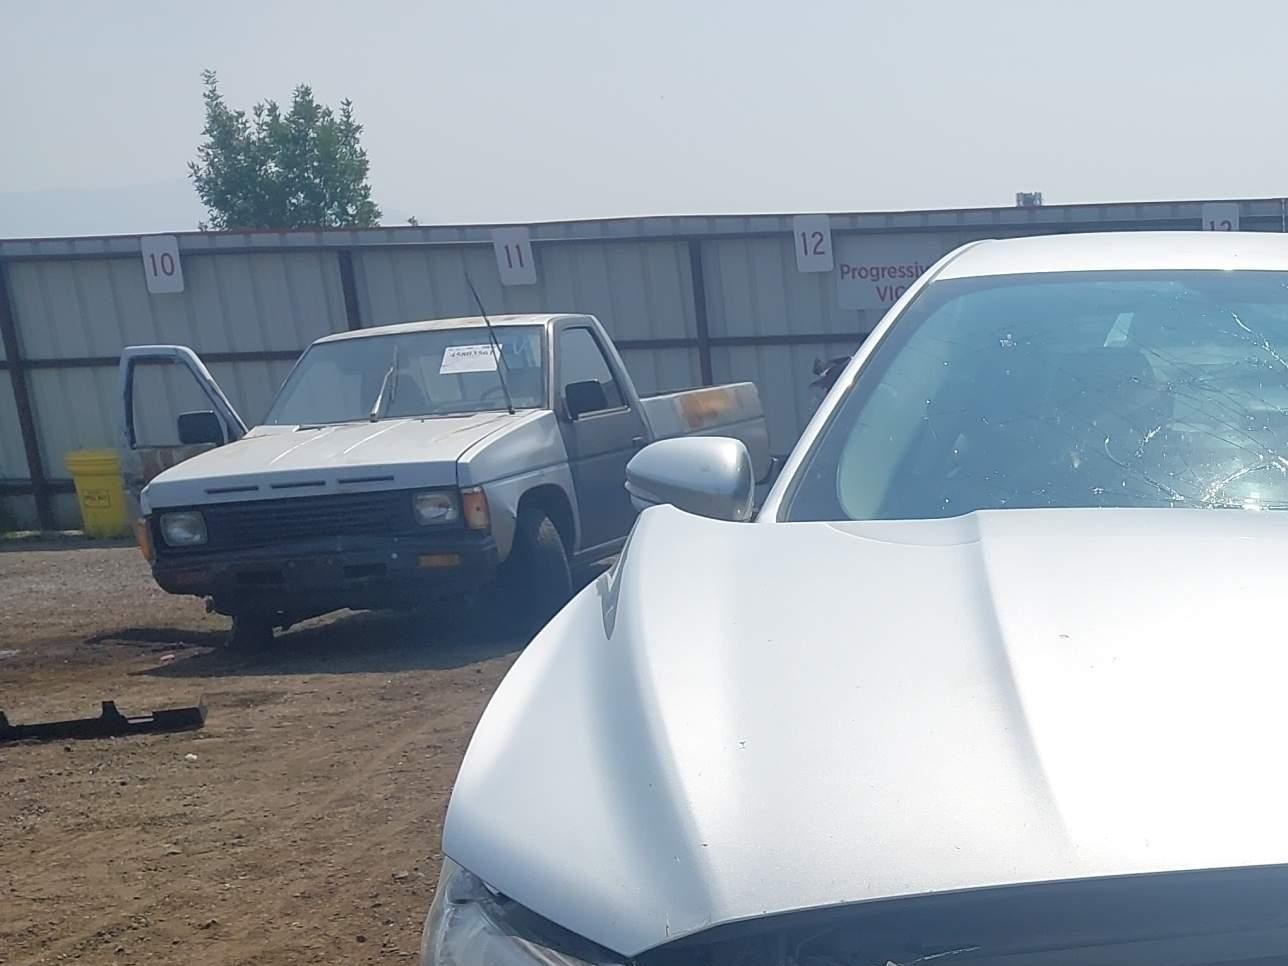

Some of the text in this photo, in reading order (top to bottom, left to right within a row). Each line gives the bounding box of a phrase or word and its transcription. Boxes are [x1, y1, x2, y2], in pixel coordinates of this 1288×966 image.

[801, 231, 825, 256] 12
[150, 252, 175, 277] 10
[503, 244, 524, 269] 11
[839, 262, 929, 281] Progressiv
